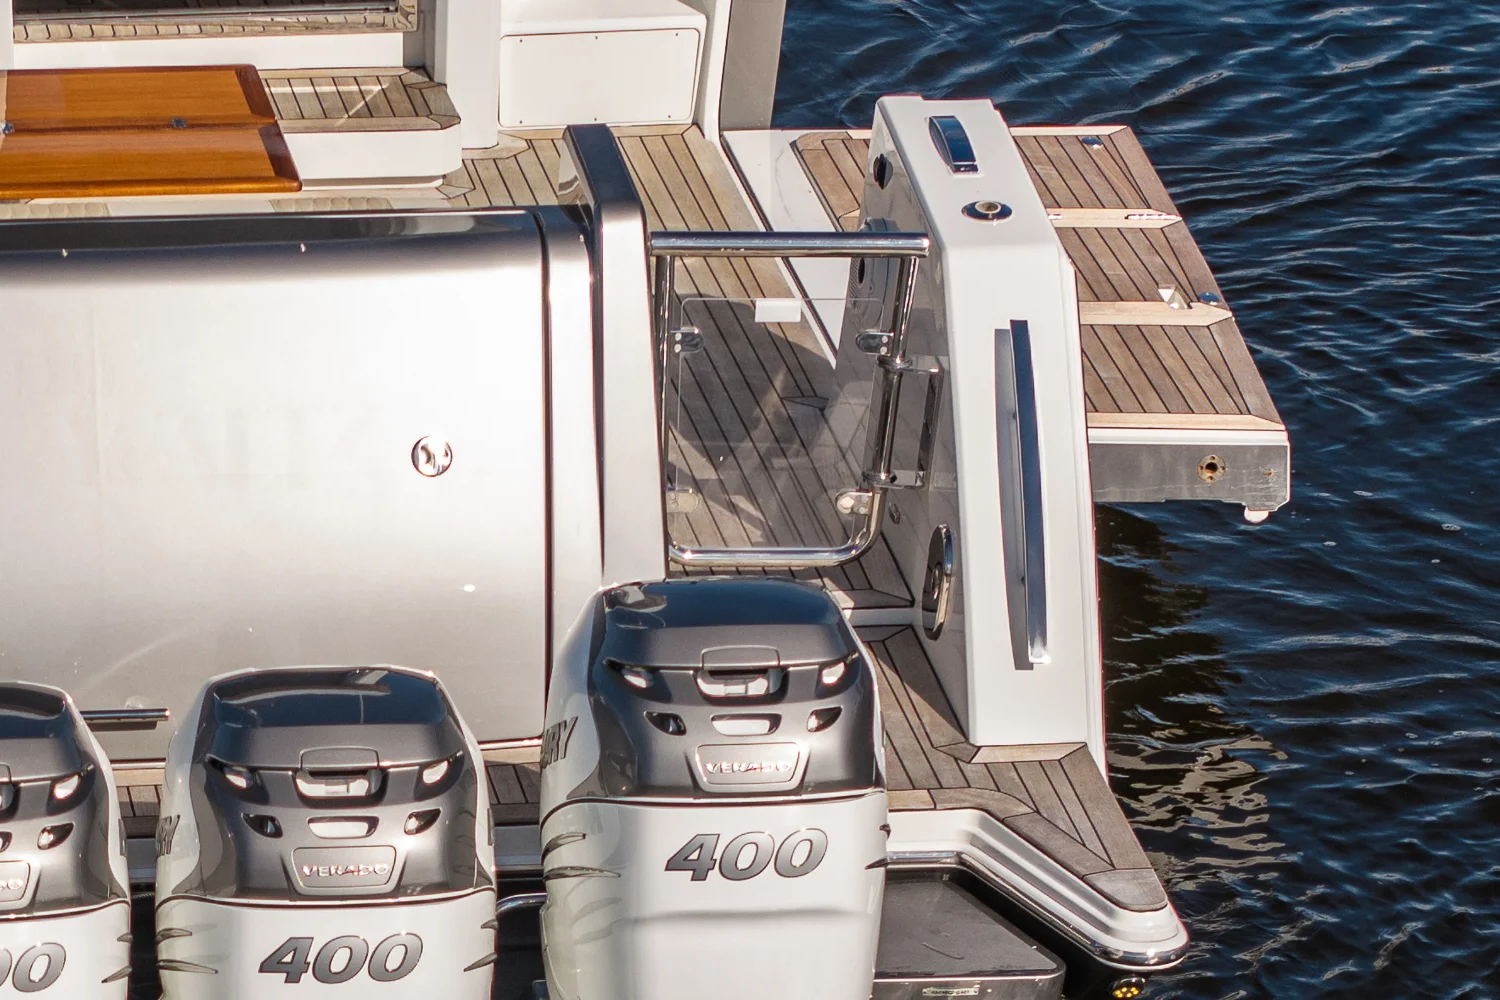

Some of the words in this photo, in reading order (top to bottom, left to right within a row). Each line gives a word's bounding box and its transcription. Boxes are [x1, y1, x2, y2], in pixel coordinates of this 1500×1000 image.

[705, 760, 792, 774] VERADO
[302, 863, 389, 877] VERADO
[664, 828, 828, 881] 400
[258, 932, 424, 984] 400
